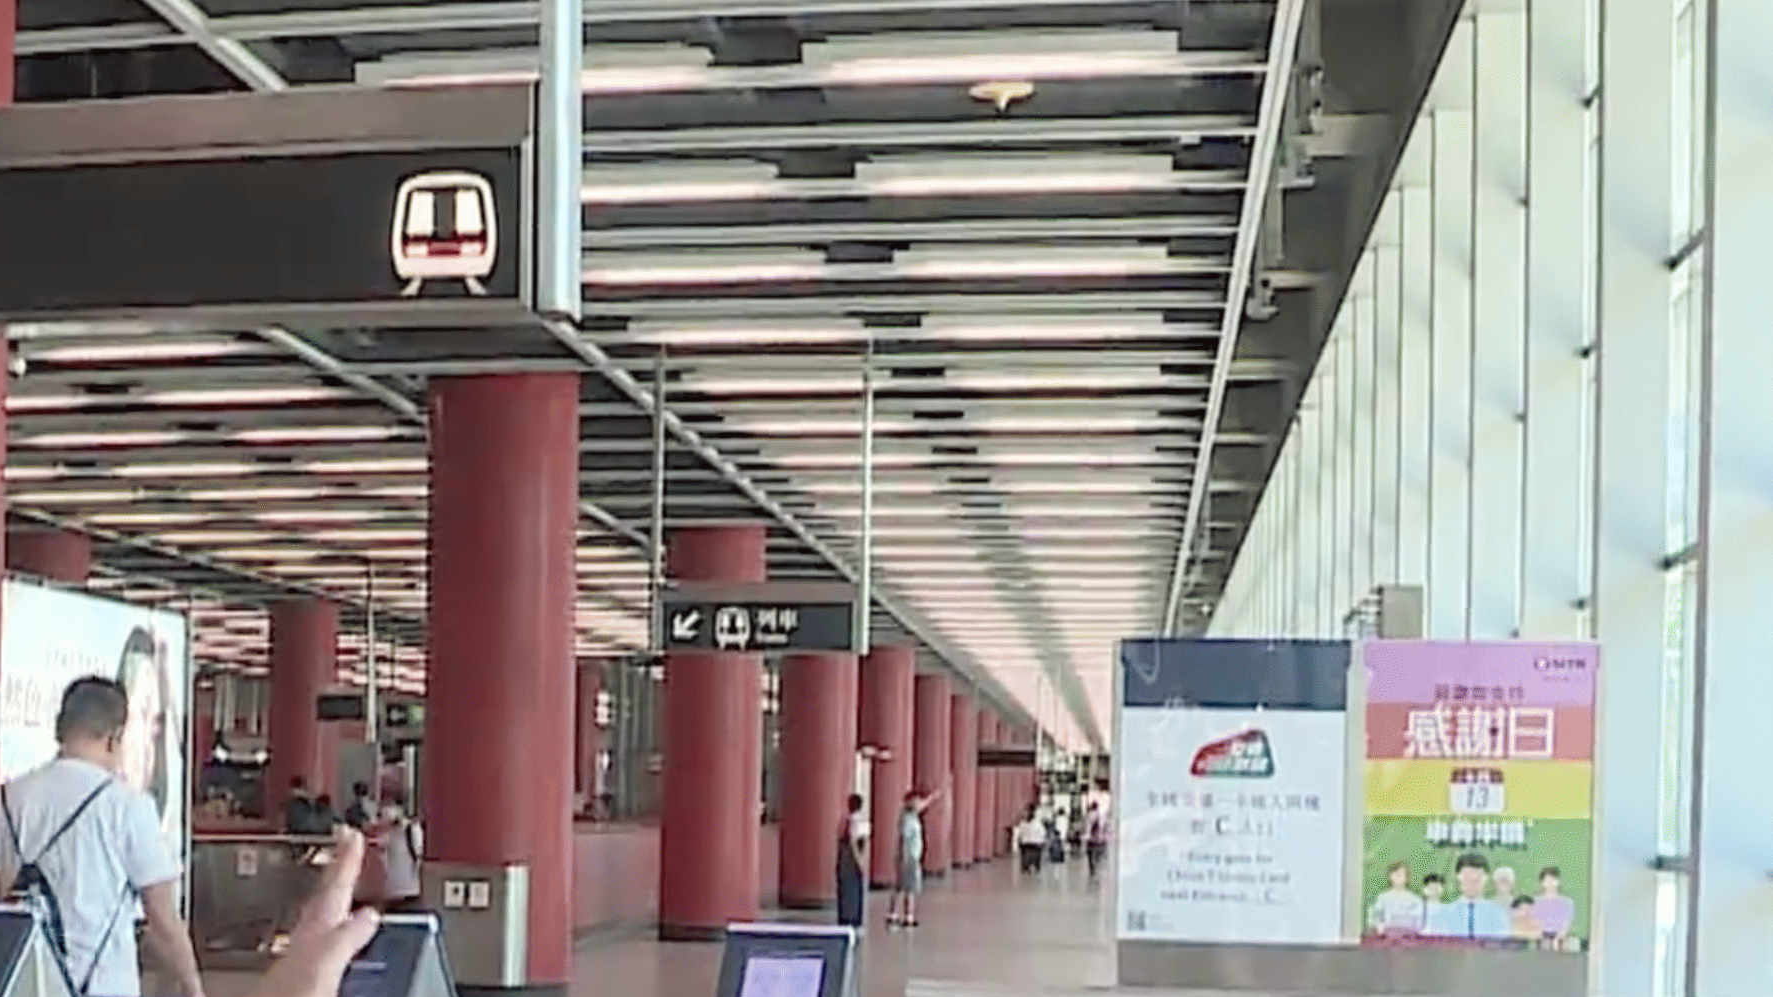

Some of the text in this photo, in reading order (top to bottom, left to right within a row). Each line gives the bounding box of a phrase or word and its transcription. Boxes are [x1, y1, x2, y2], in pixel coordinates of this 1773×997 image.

[1403, 702, 1556, 760] 感謝日
[1466, 786, 1490, 809] 13
[1215, 816, 1231, 837] C
